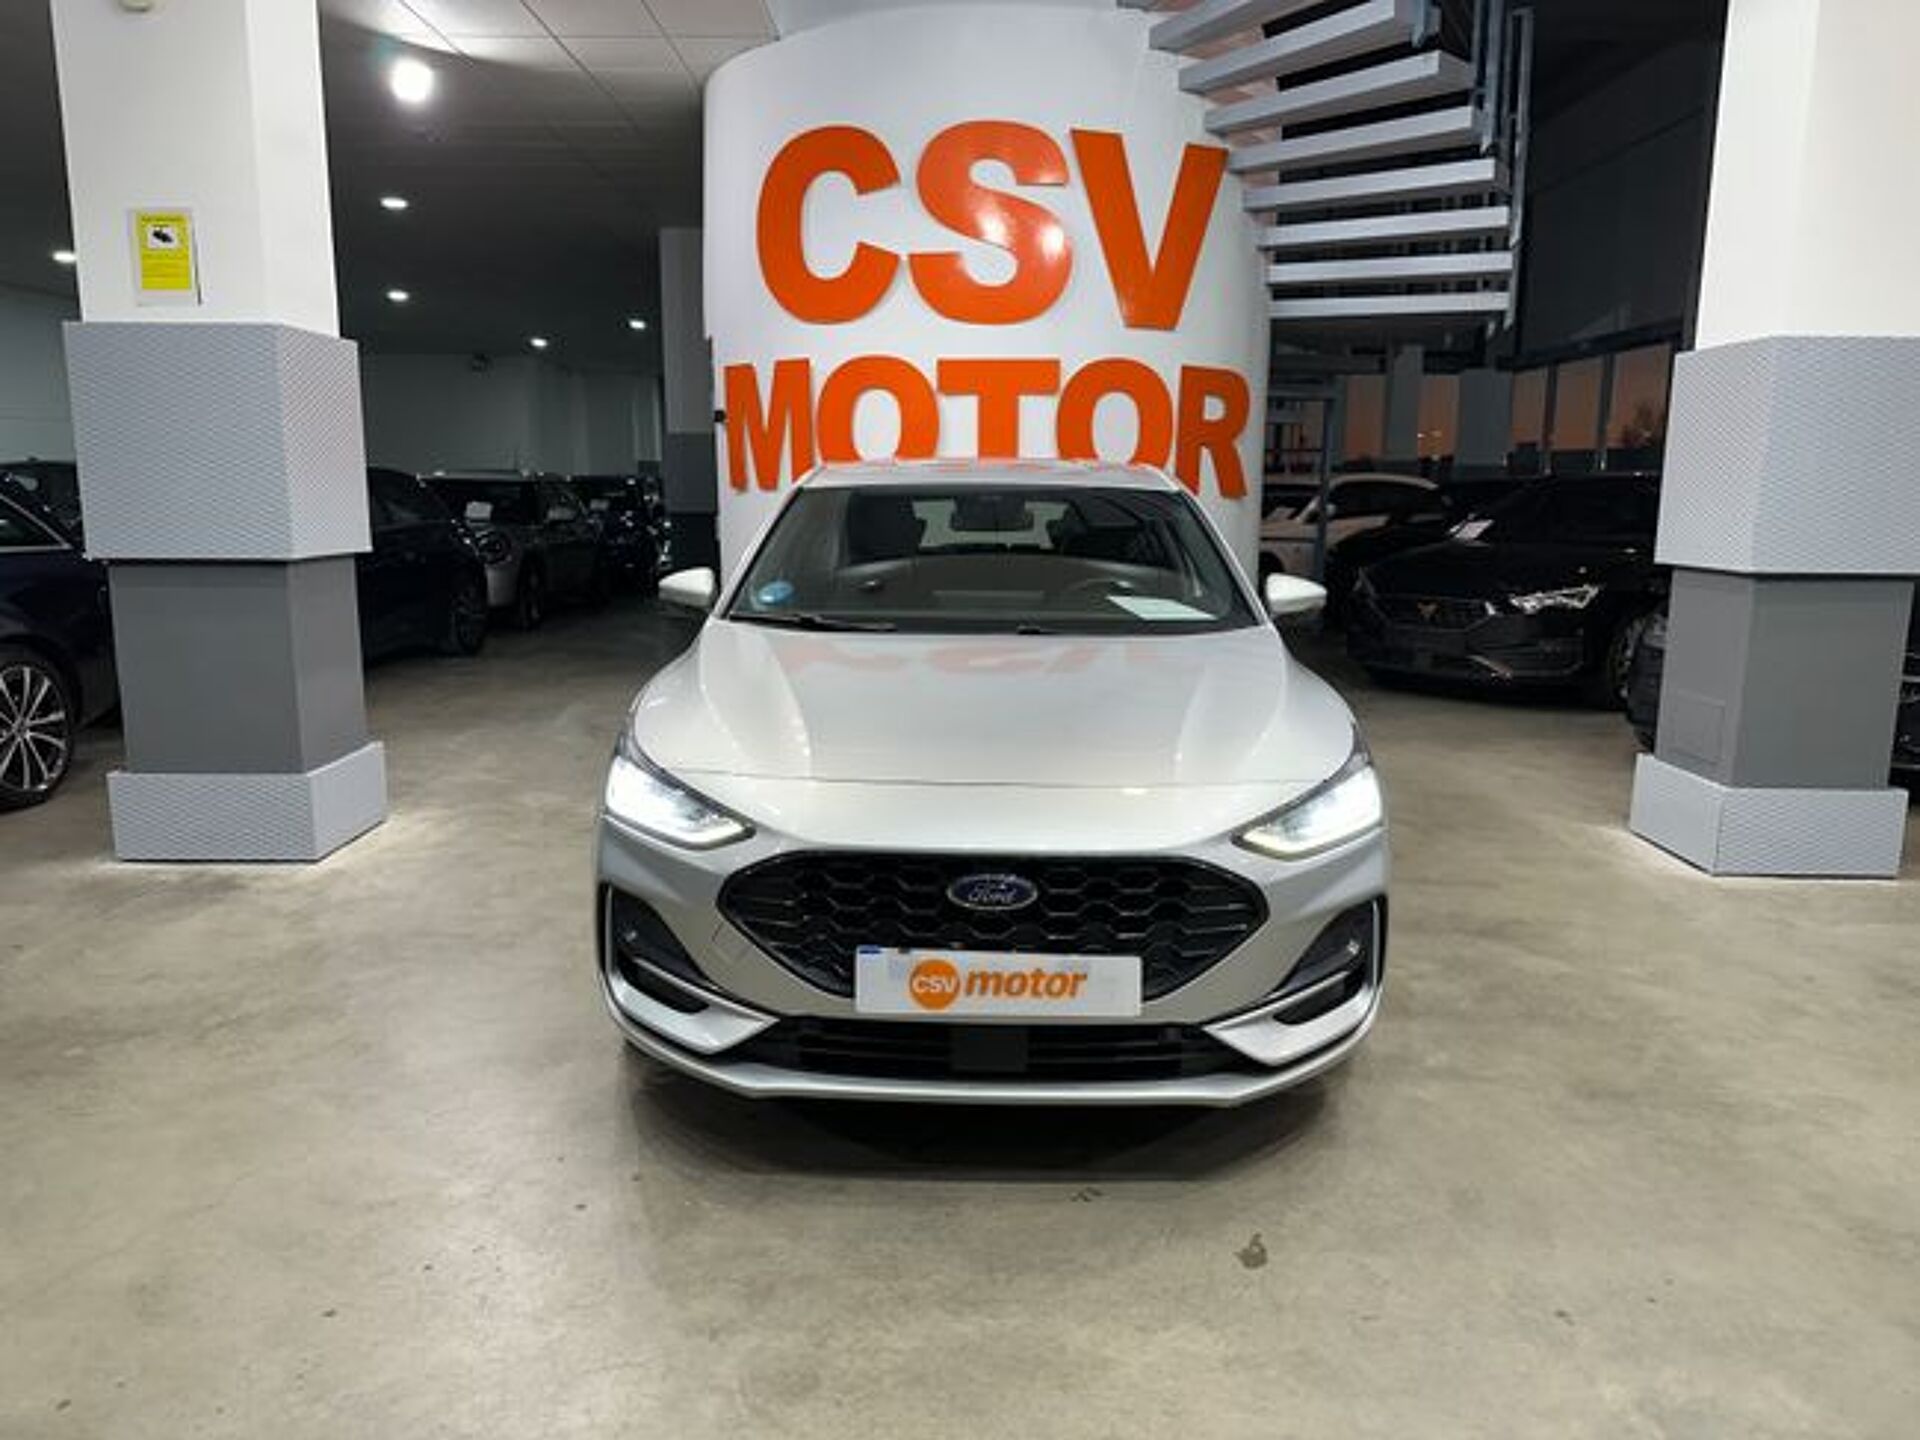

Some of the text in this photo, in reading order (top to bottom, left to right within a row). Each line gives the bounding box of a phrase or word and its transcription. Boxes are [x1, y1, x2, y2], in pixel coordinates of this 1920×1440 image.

[756, 120, 1230, 331] CSV
[724, 355, 1251, 499] MOTOR
[967, 882, 1017, 903] Ford
[965, 969, 1087, 997] motor
